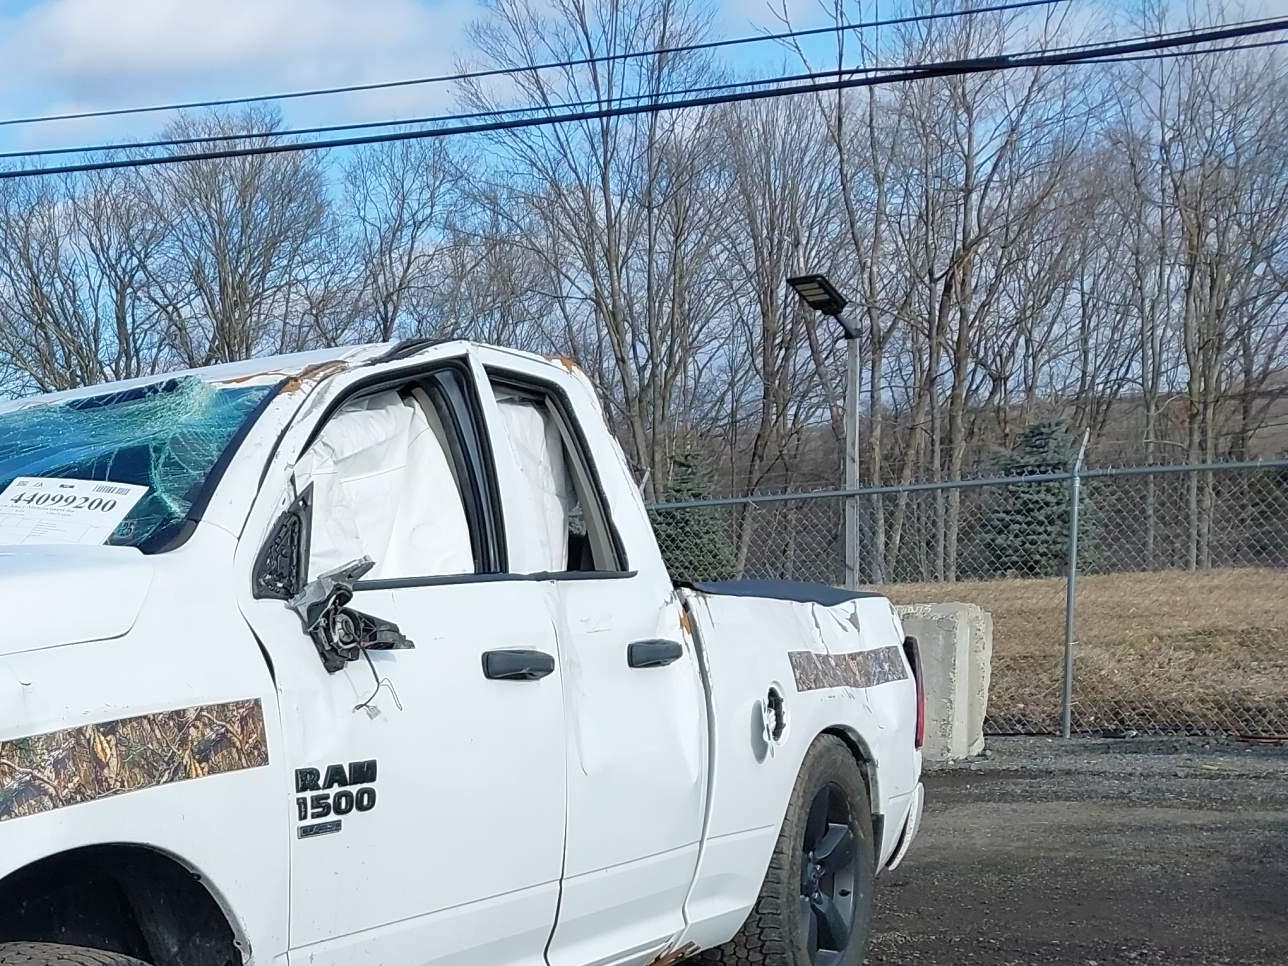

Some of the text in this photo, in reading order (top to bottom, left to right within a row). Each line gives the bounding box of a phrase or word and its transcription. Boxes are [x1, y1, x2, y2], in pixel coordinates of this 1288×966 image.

[10, 491, 118, 513] 44099200
[294, 758, 378, 793] RAM
[296, 787, 377, 821] 1500
